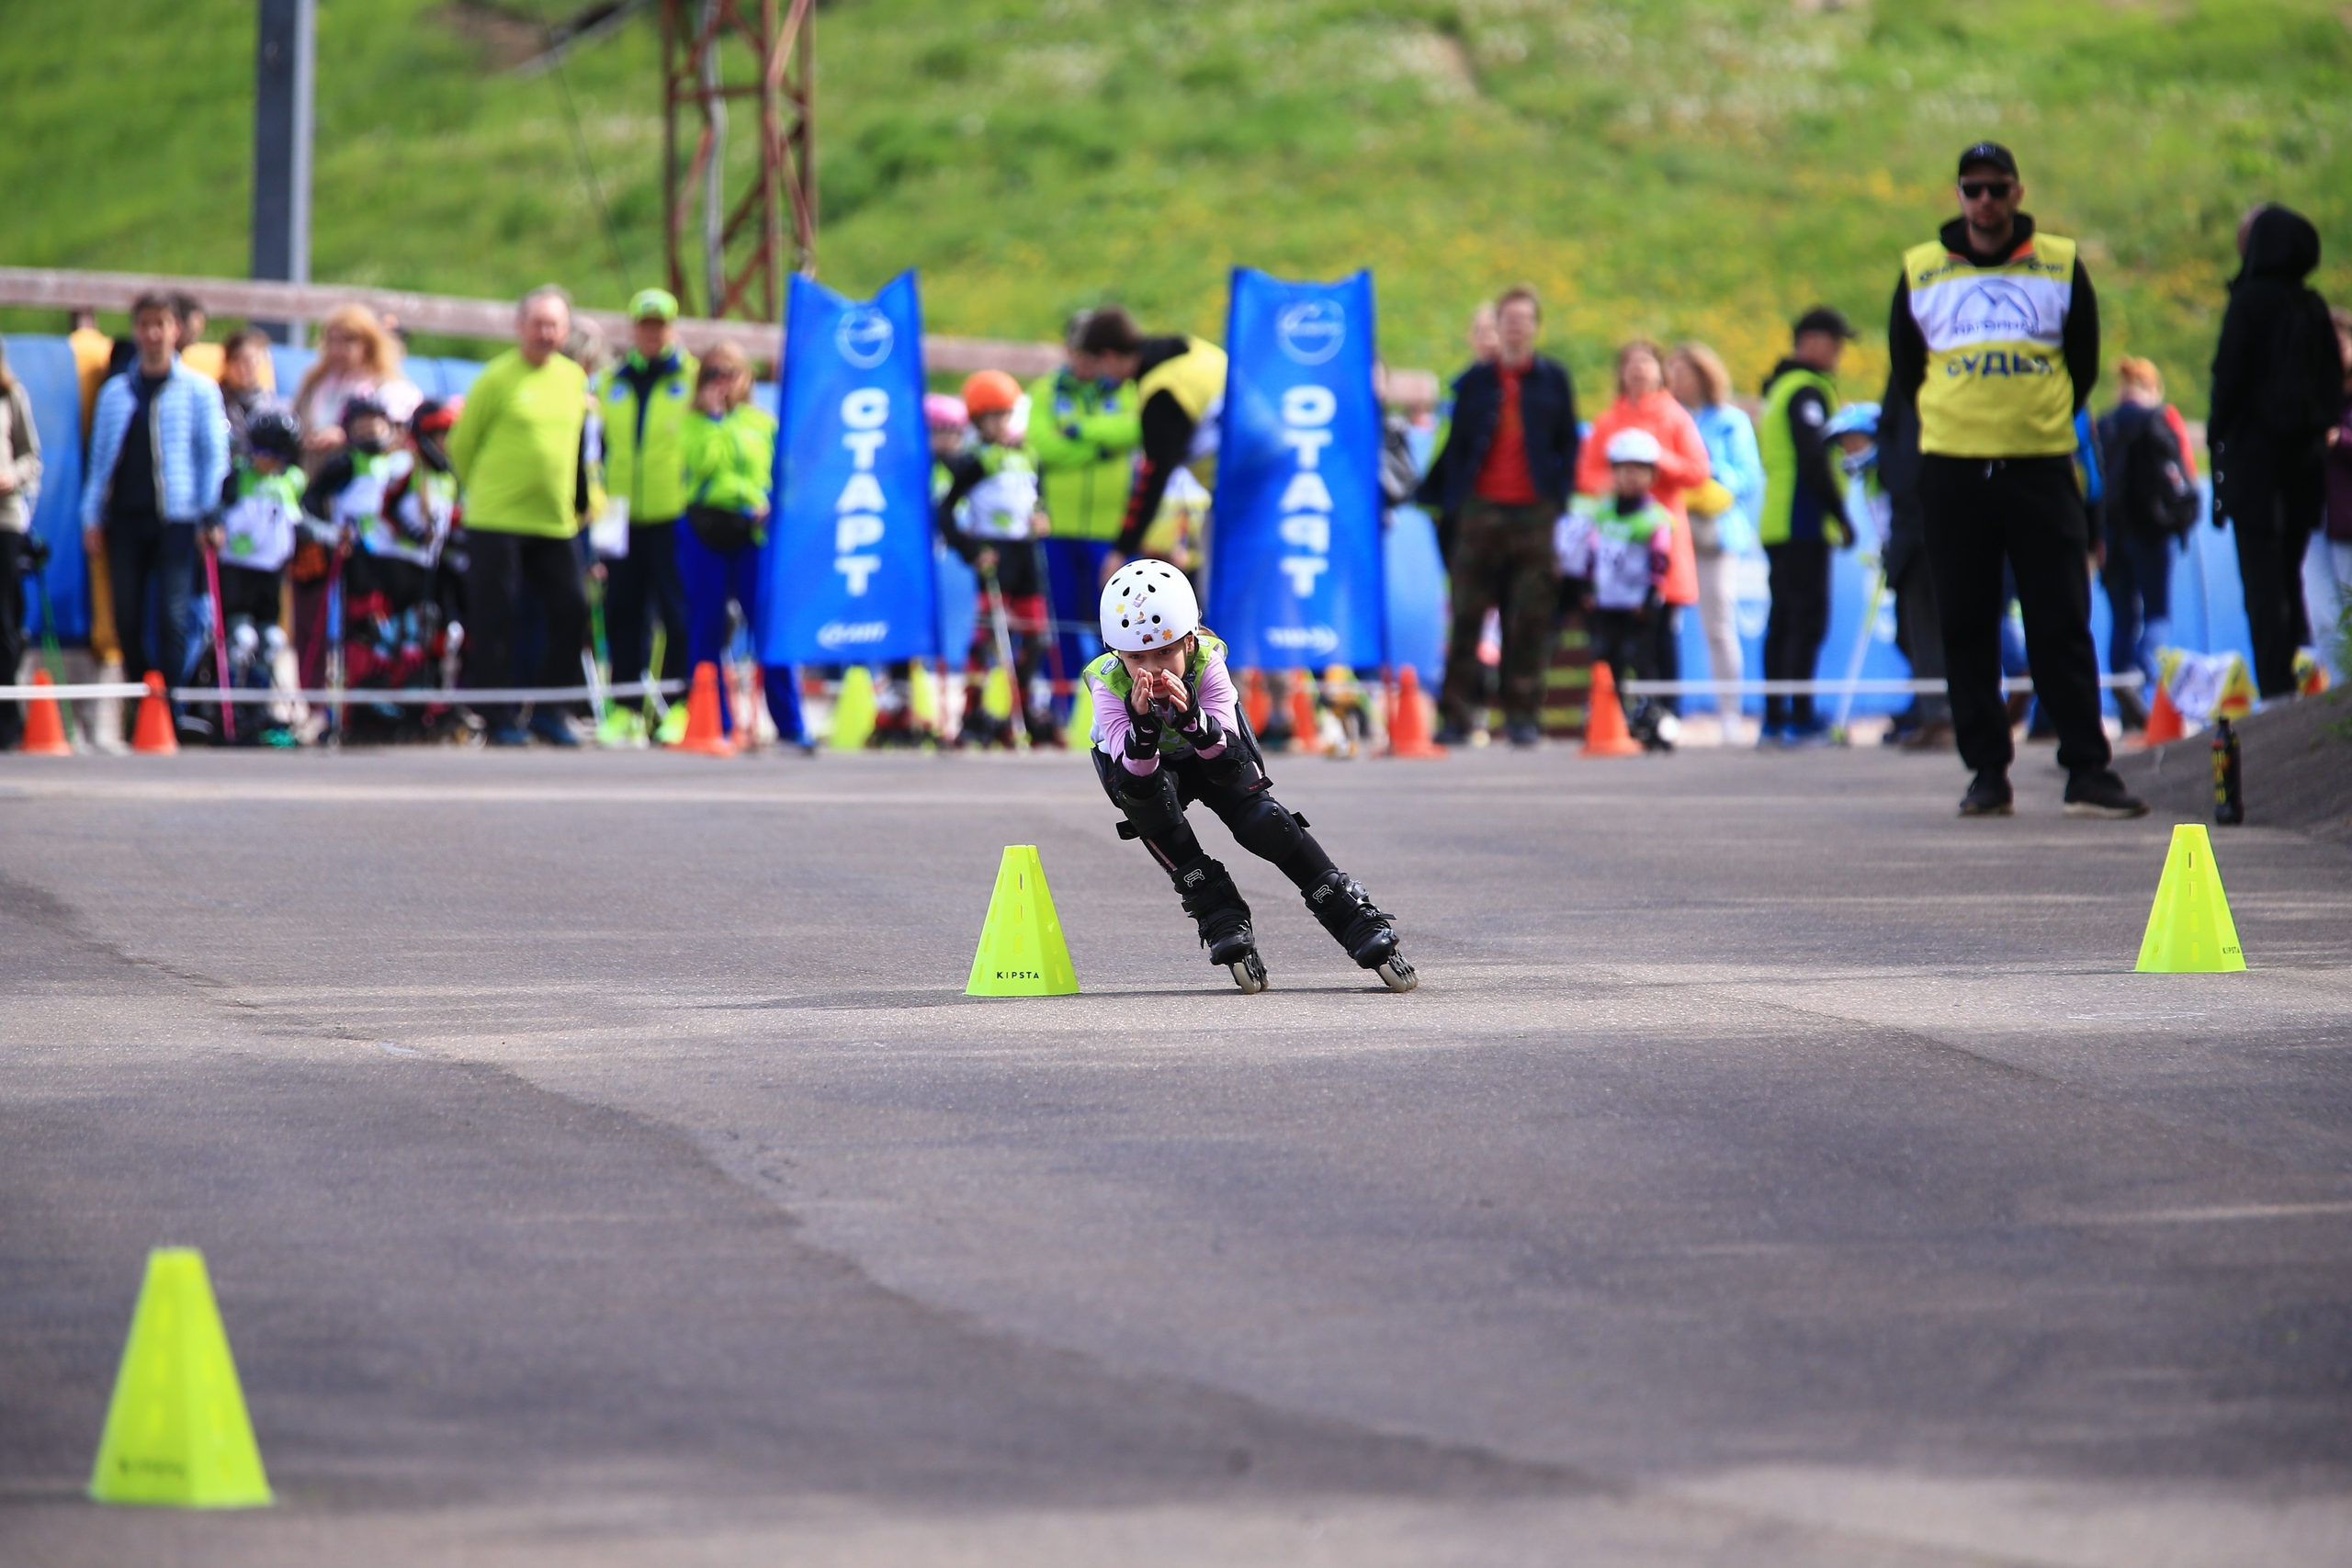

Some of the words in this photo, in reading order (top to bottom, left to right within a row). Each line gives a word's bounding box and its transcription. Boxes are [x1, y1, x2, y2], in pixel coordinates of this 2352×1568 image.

[1946, 352, 2053, 377] СУДЬЯ
[833, 386, 891, 599] СТАРТ
[996, 971, 1040, 979] KIPSTA
